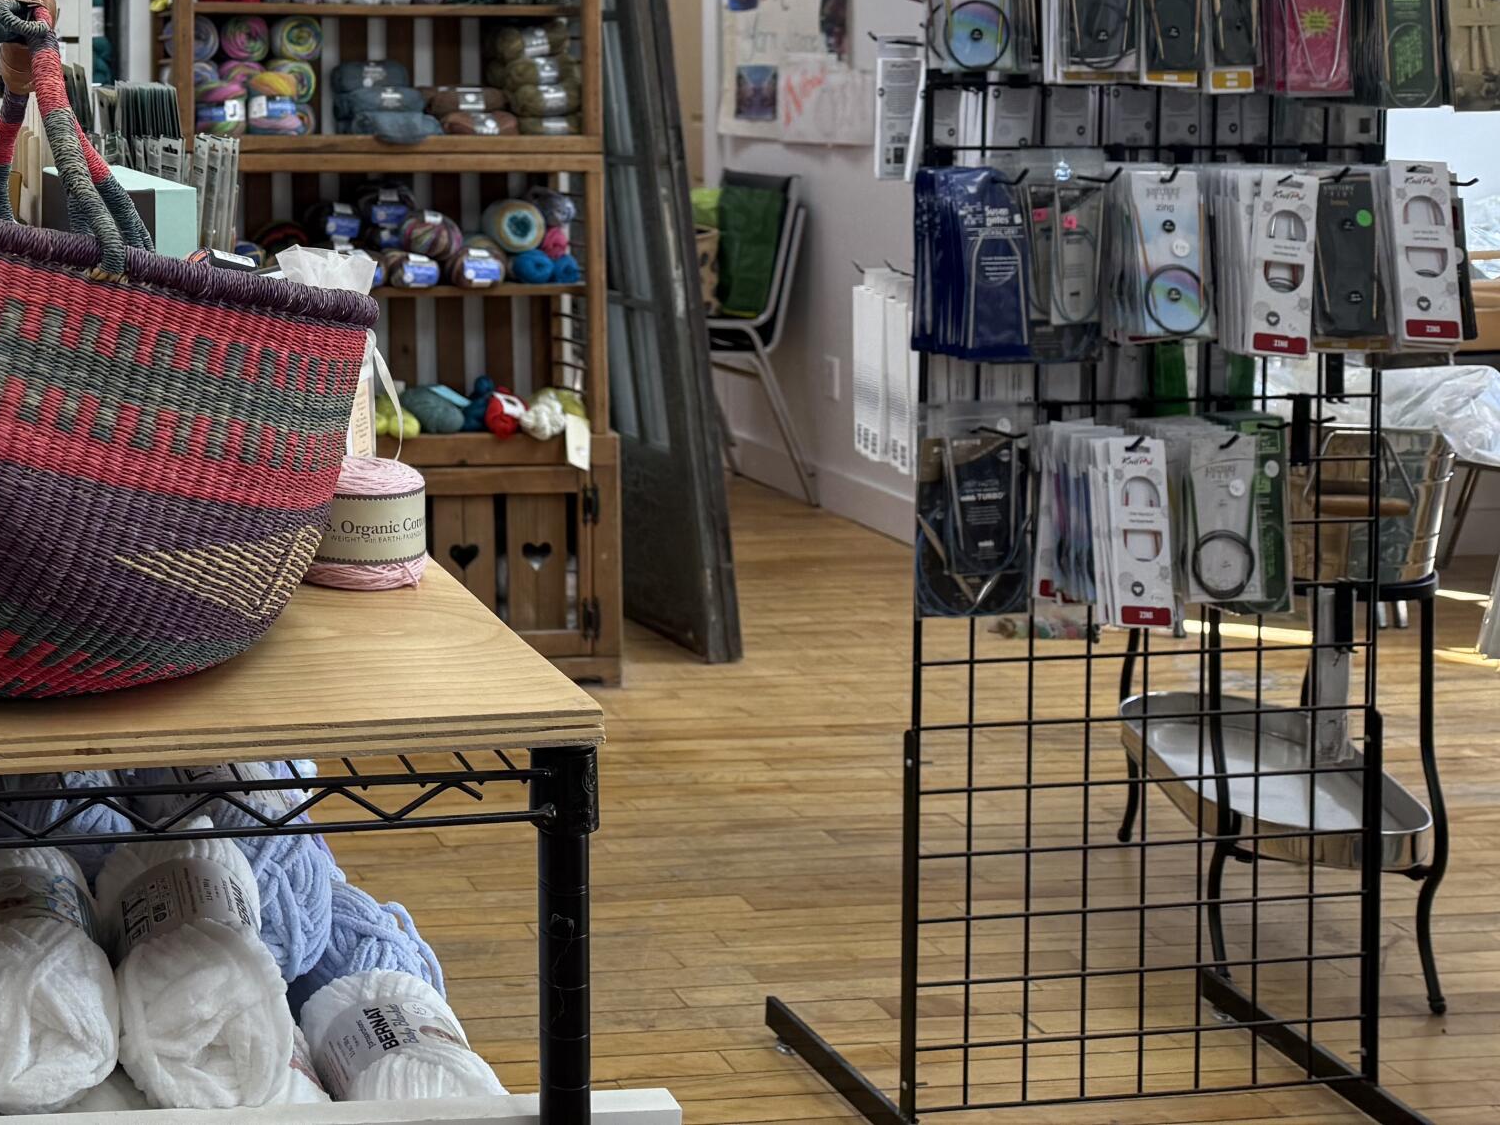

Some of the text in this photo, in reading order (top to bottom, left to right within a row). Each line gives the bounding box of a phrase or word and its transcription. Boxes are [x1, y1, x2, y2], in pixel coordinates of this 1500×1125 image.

[1155, 203, 1175, 213] zing
[977, 491, 1004, 501] TURBO
[341, 520, 400, 539] Organic
[331, 535, 361, 543] WEIGHT
[362, 1006, 400, 1052] BERNAT
[402, 1026, 420, 1045] Baby
